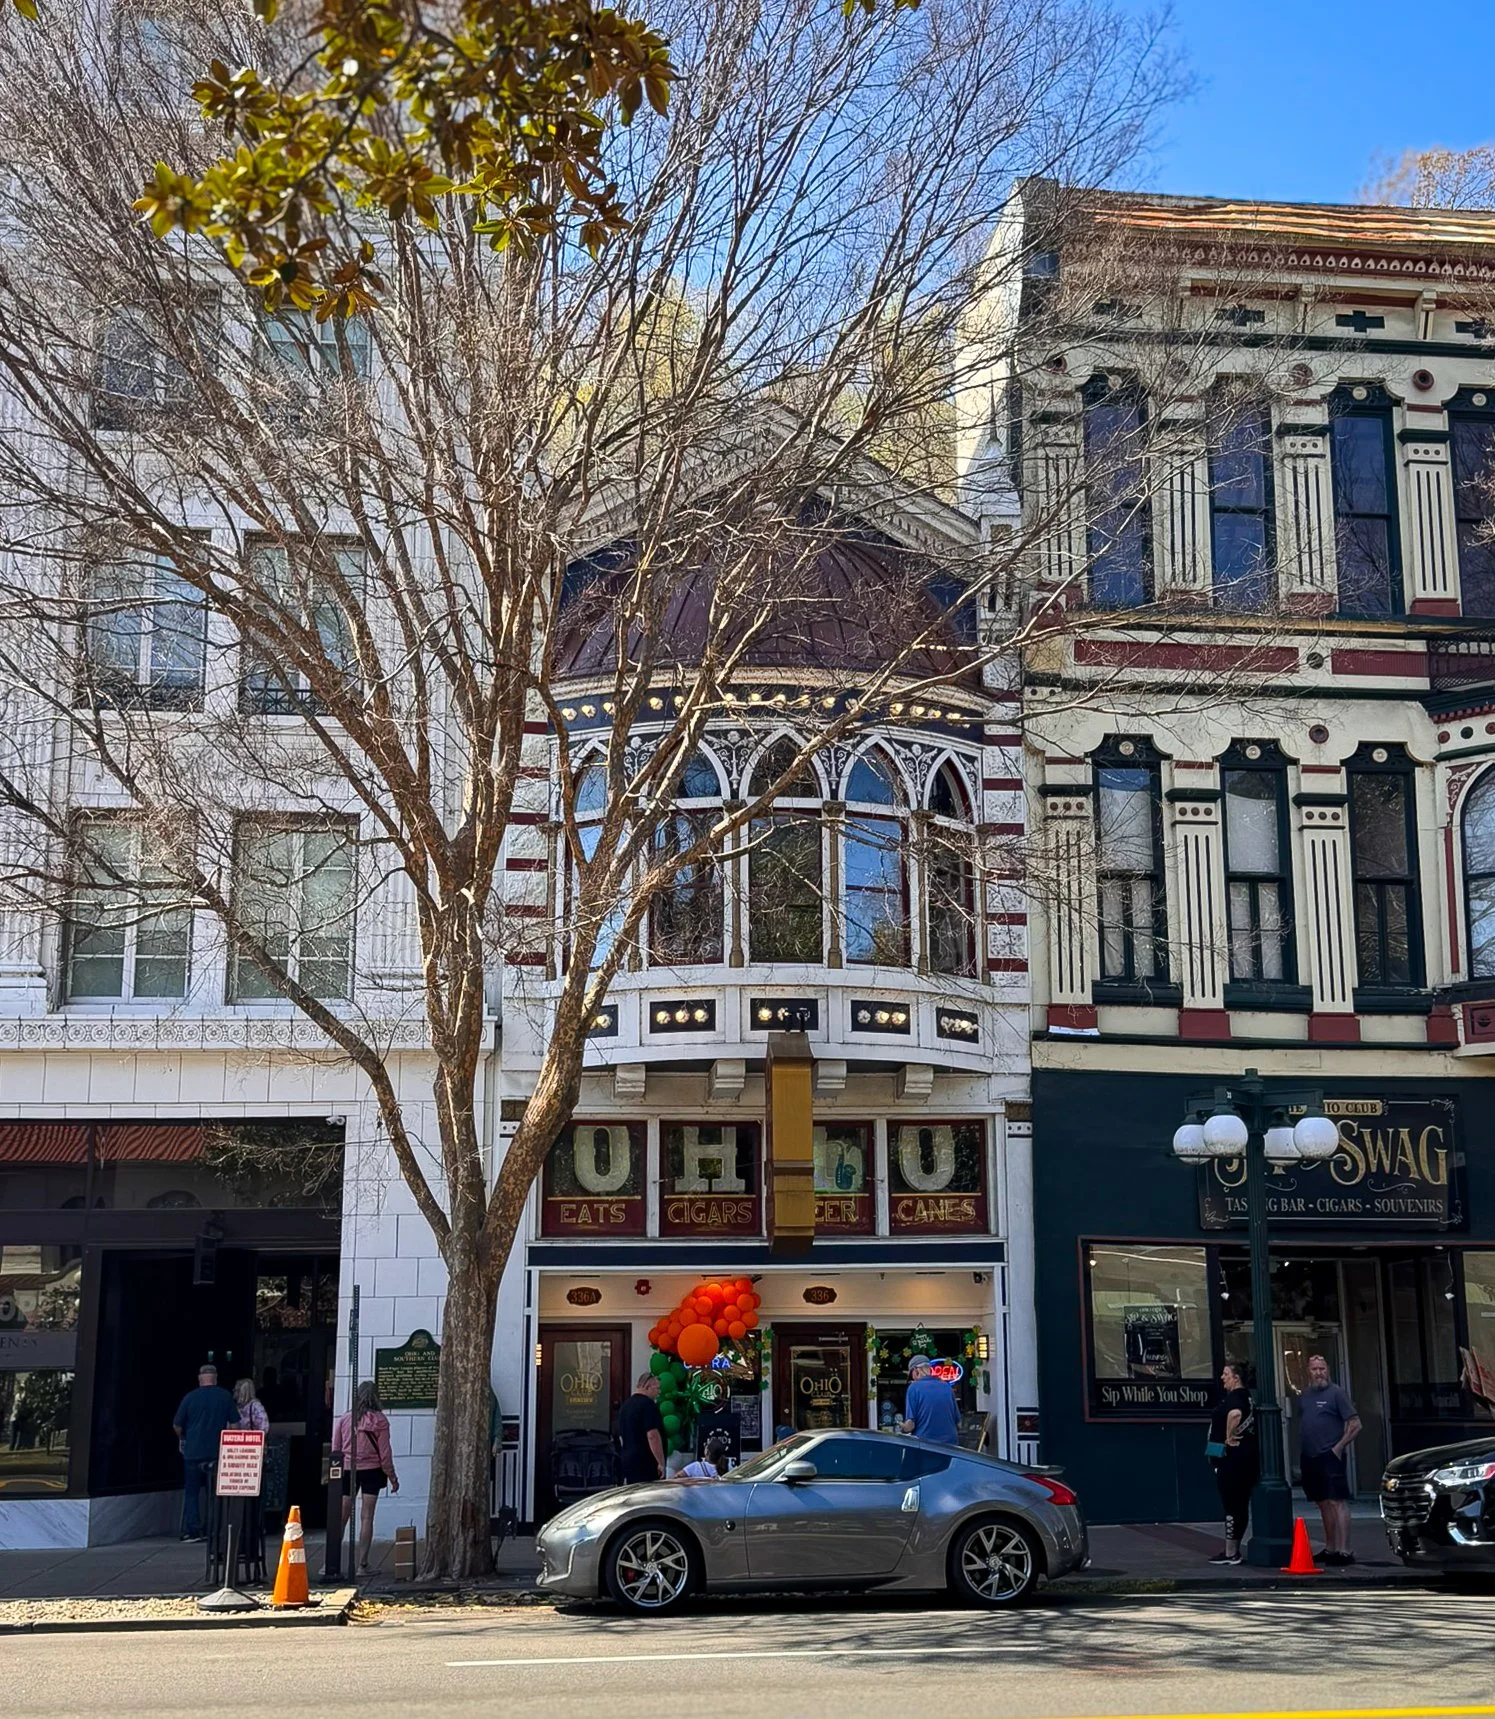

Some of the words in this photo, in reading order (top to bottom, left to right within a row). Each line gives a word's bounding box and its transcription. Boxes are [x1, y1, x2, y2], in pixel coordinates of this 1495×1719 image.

[1346, 1102, 1378, 1113] CLUB
[1330, 1119, 1448, 1186] SWAG
[559, 1203, 626, 1224] EATS
[667, 1202, 753, 1224] CIGARS
[814, 1201, 859, 1222] EER
[1281, 1198, 1306, 1212] BAR
[1316, 1198, 1363, 1212] CIGARS
[1374, 1199, 1443, 1213] SOUVENIRS
[570, 1290, 597, 1303] 336A
[811, 1290, 829, 1301] 336
[560, 1373, 604, 1392] OHIO
[800, 1376, 842, 1394] OHIO
[1102, 1386, 1120, 1407] Sip
[1122, 1386, 1155, 1403] While
[1156, 1386, 1178, 1402] You
[1180, 1386, 1208, 1407] Shop
